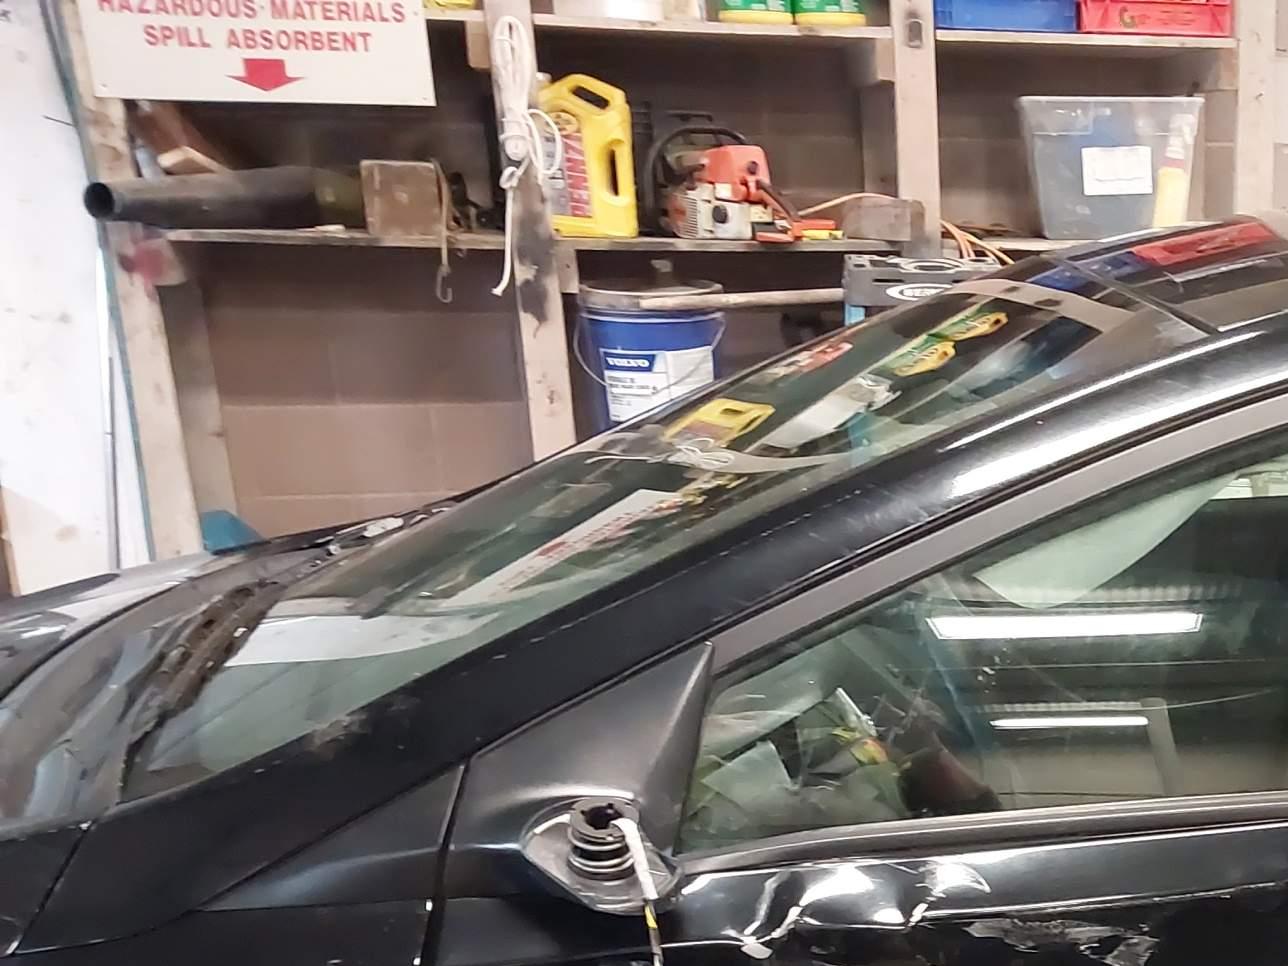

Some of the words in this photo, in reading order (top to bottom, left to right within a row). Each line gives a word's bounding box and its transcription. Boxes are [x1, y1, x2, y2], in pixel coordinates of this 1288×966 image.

[97, 0, 257, 18] HAZARDOUS
[270, 0, 406, 23] MATERIALS
[143, 24, 212, 48] SPILL
[227, 28, 372, 52] ABSORBENT
